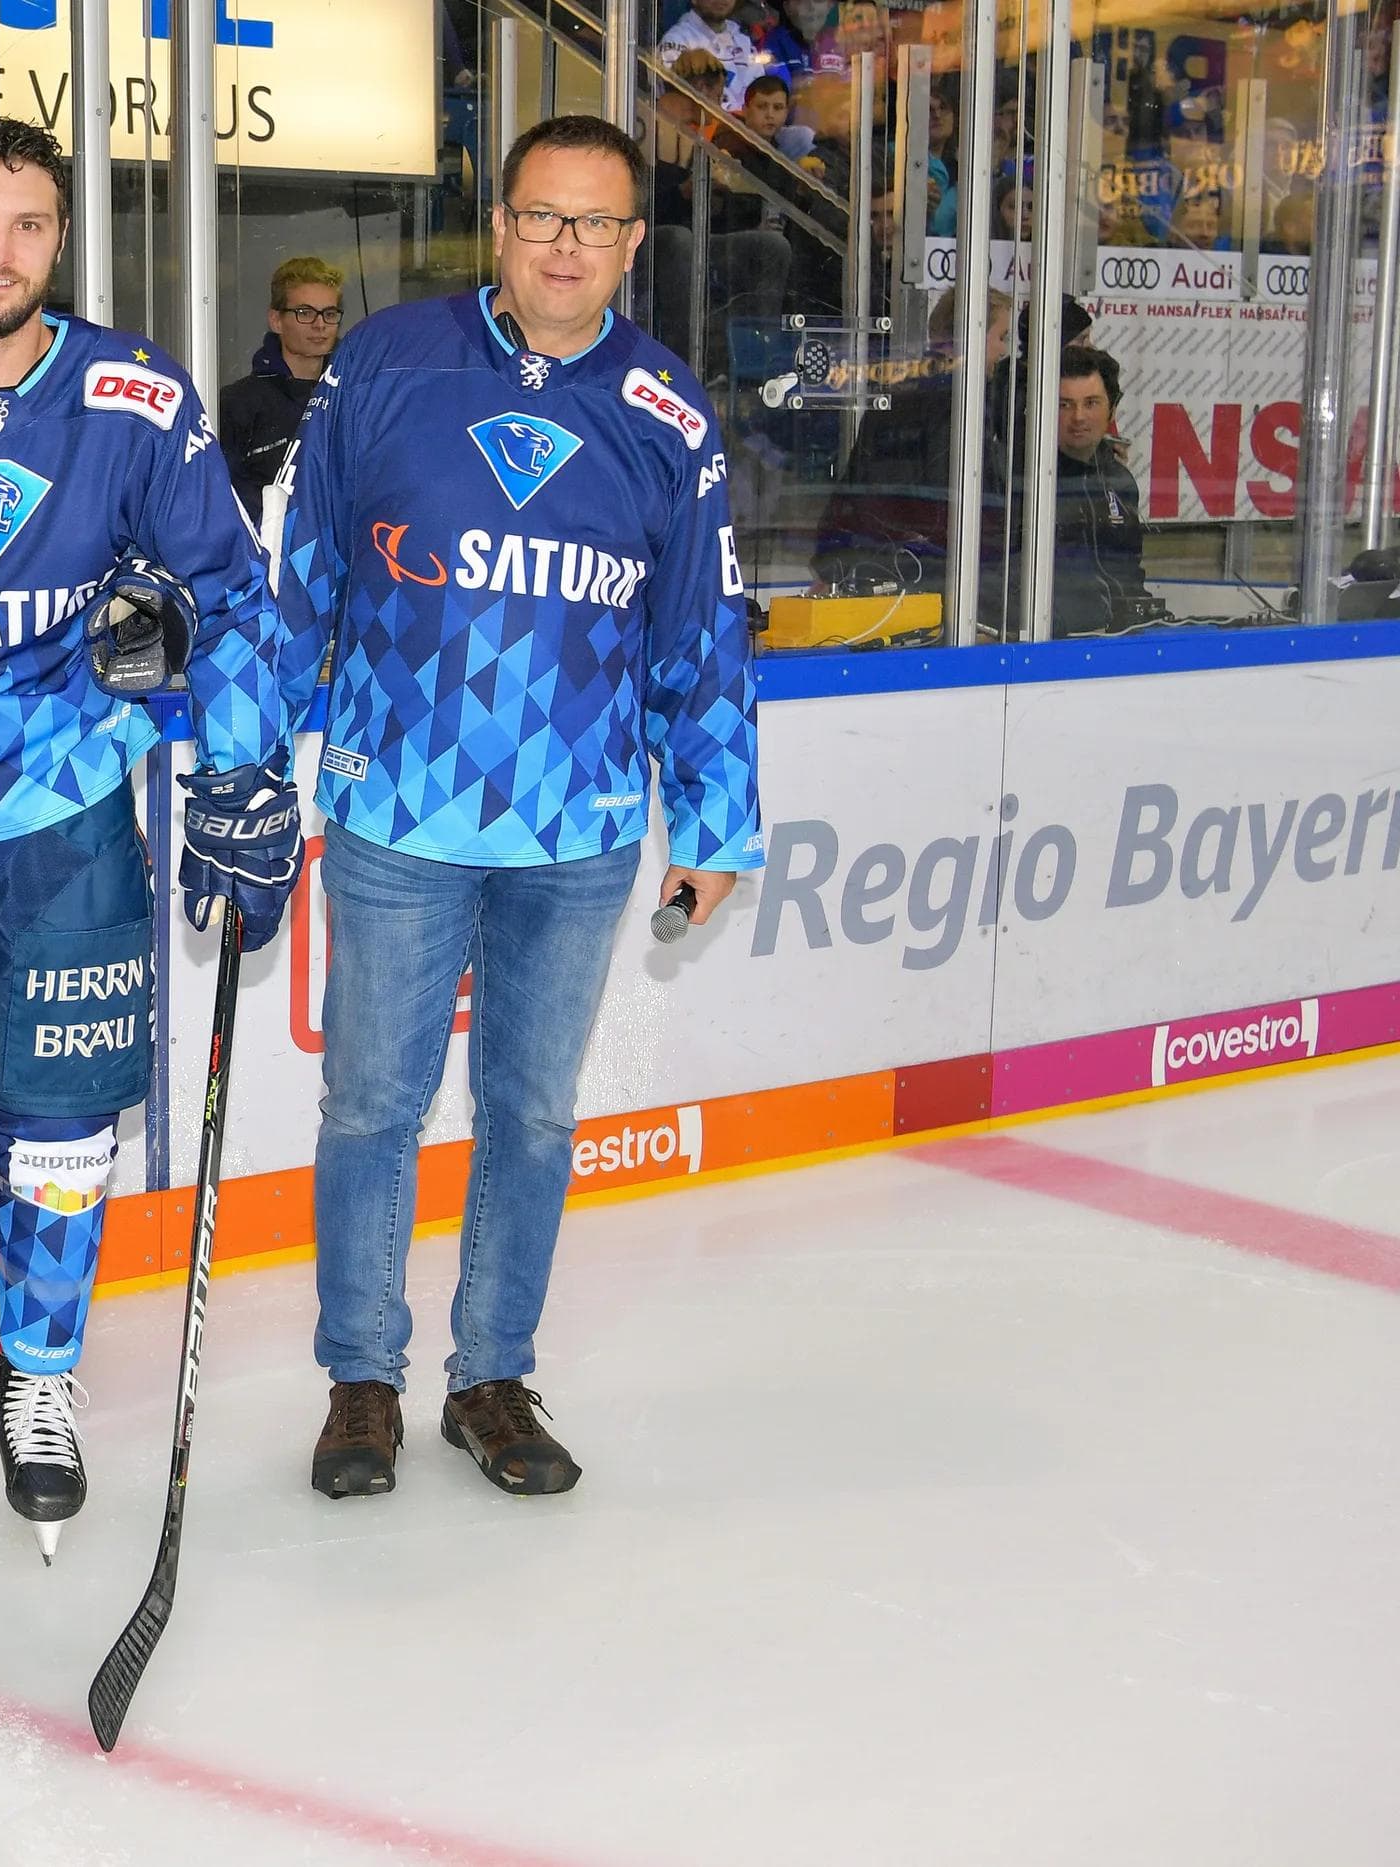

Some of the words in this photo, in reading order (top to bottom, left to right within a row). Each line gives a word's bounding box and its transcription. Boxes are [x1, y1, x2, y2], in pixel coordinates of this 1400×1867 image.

[29, 69, 276, 142] VRUS
[1171, 263, 1233, 290] Audi
[1105, 303, 1138, 316] FLEX
[1201, 306, 1232, 319] FLEX
[1288, 308, 1308, 322] FLE
[455, 529, 647, 609] SATURN
[750, 793, 1077, 971] Regio
[26, 954, 145, 1003] HERRN
[33, 1013, 135, 1059] BRÄU
[1167, 1014, 1301, 1069] covestro
[571, 1126, 677, 1177] estro
